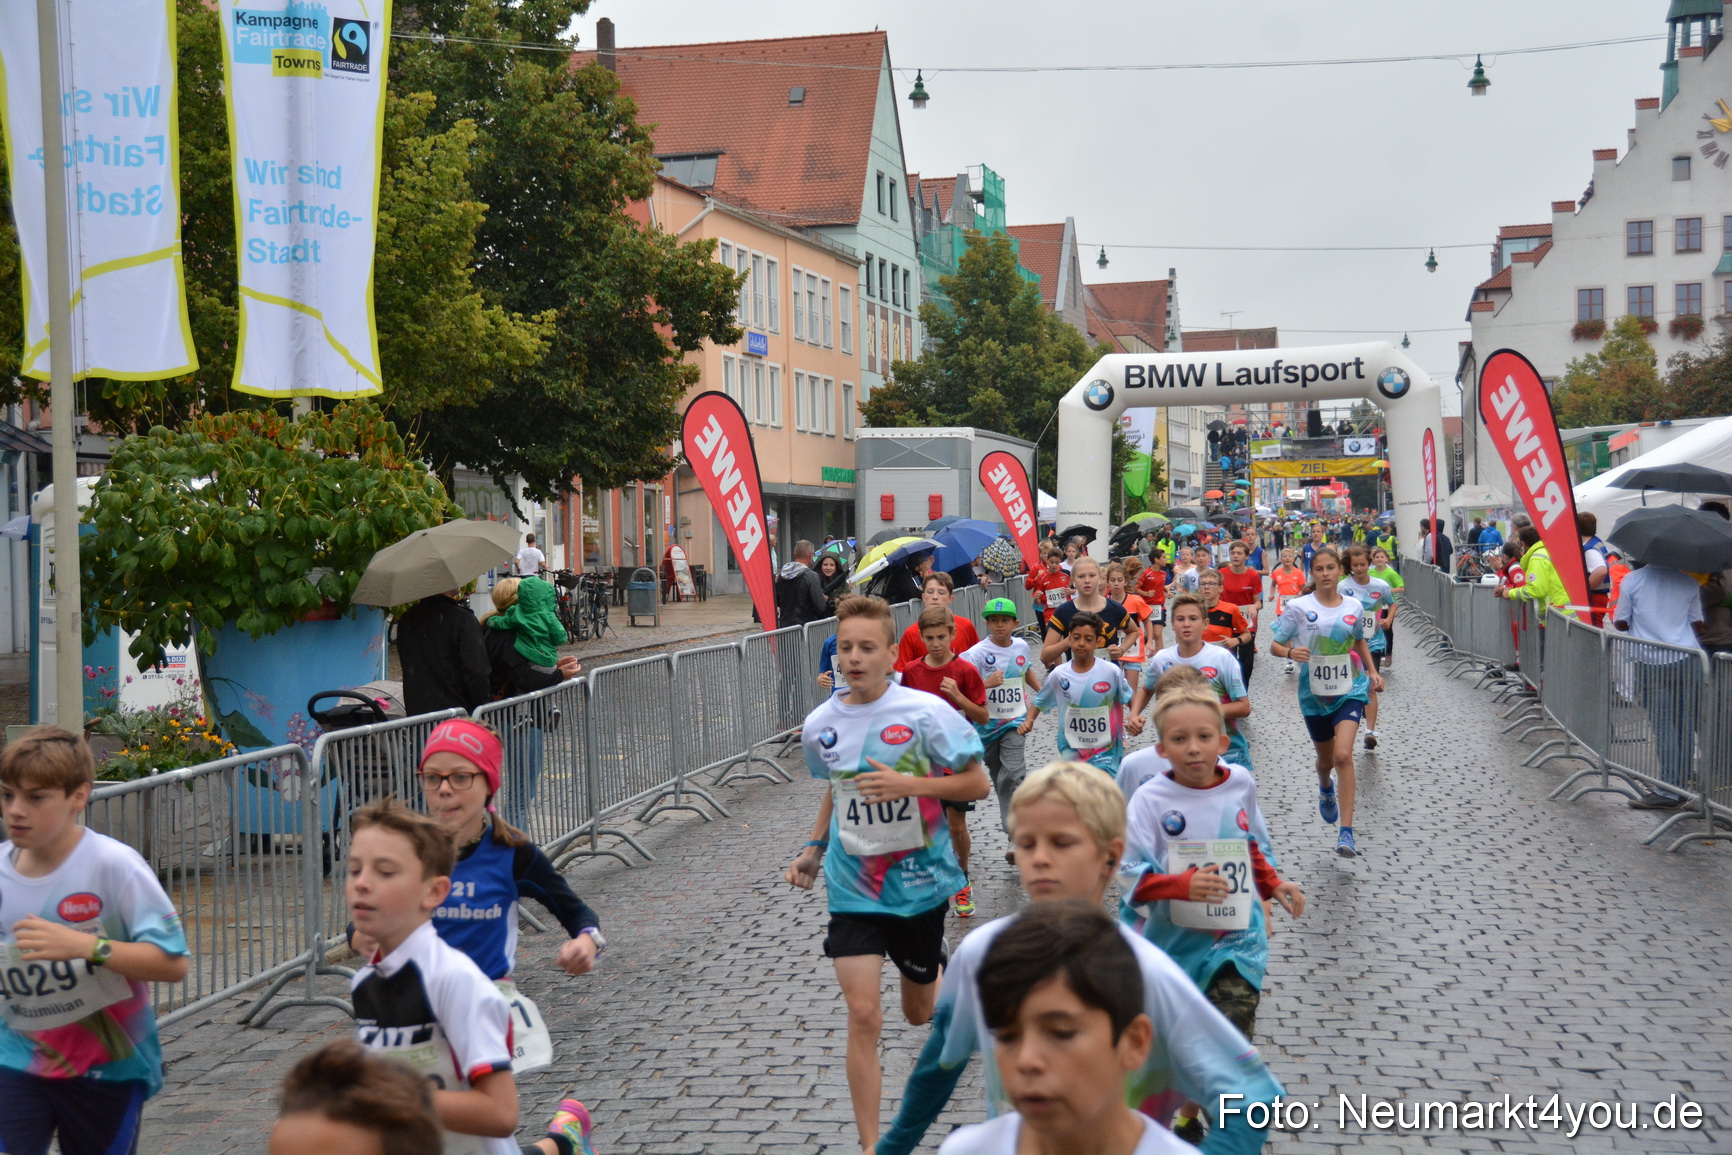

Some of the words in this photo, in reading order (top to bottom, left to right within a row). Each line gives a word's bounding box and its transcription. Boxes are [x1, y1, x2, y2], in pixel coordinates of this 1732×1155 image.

[236, 12, 318, 29] Kampagne
[237, 27, 326, 49] Fairtrade
[275, 56, 321, 71] Towns
[333, 61, 367, 71] FAIRTRADE
[245, 158, 288, 185] Wir
[297, 160, 342, 190] sind
[248, 238, 321, 264] Stadt
[1125, 363, 1207, 389] BMW
[1215, 357, 1365, 389] Laufsport
[1301, 462, 1329, 474] ZIEL
[1314, 665, 1348, 680] 4014
[988, 688, 1021, 703] 4035
[1069, 717, 1106, 733] 4036
[847, 796, 912, 826] 4102
[899, 857, 920, 870] 17.
[451, 881, 475, 897] 21
[1206, 904, 1236, 917] Luca
[10, 998, 85, 1018] Maximilian
